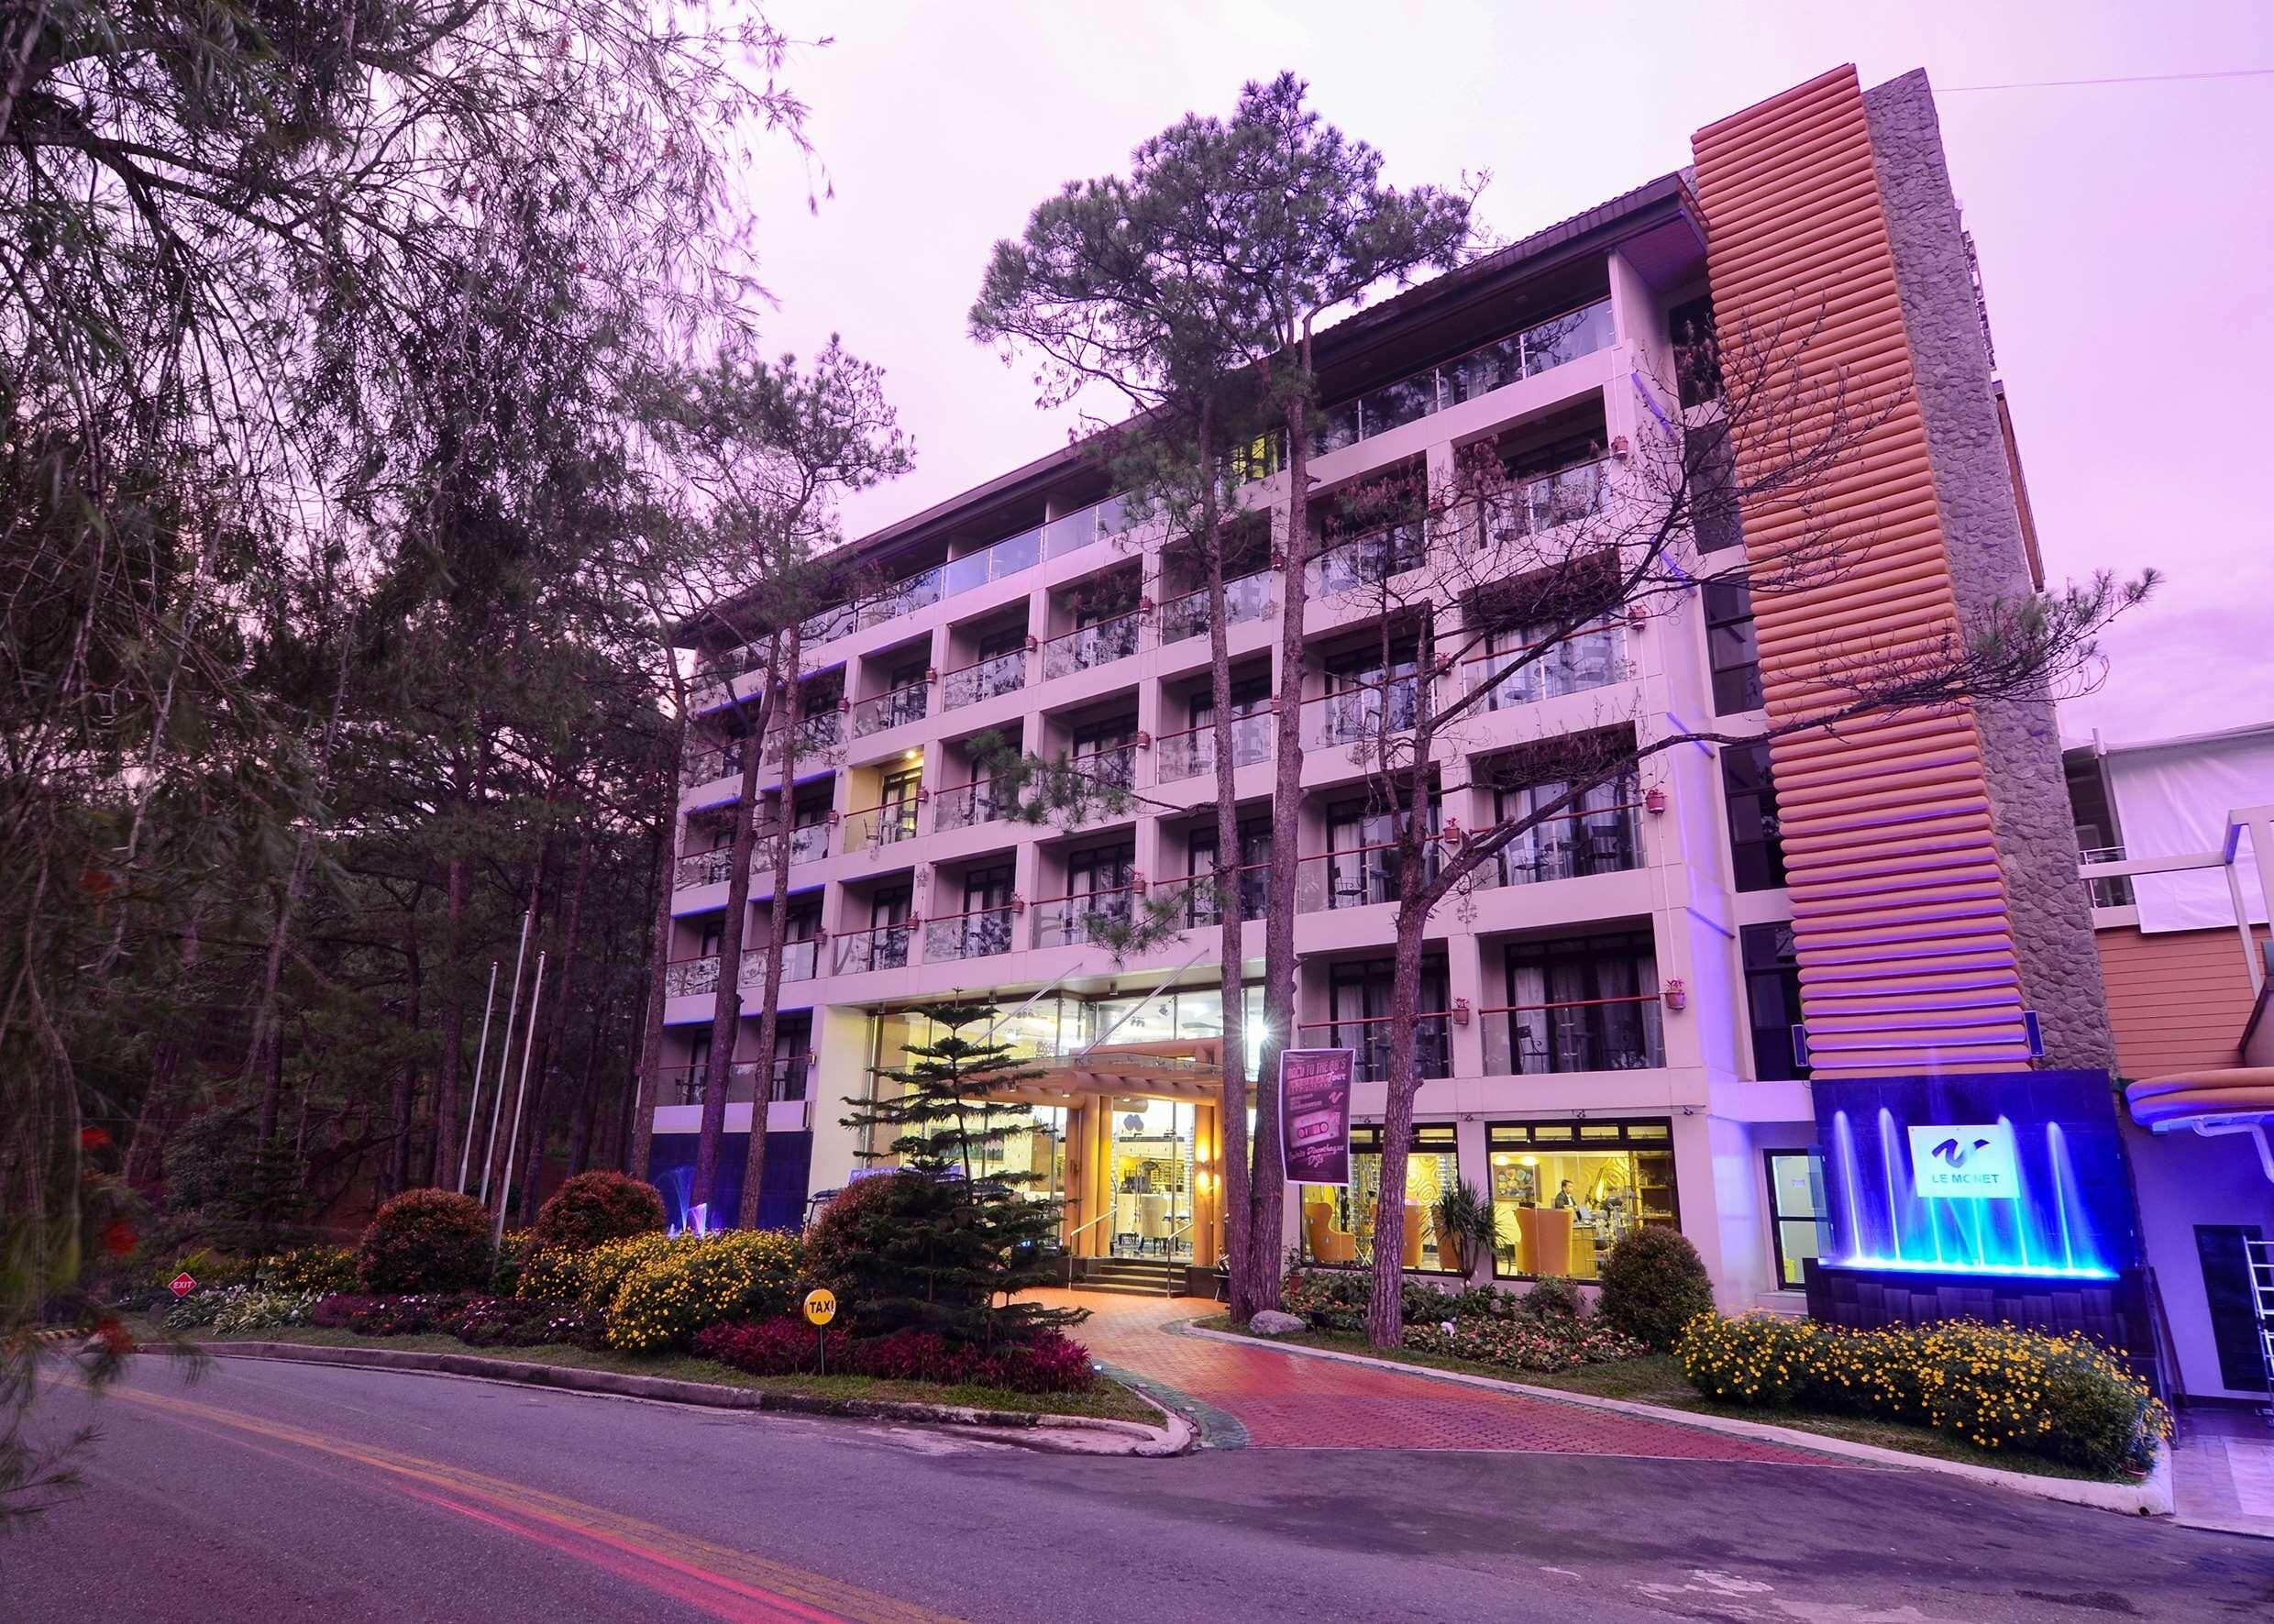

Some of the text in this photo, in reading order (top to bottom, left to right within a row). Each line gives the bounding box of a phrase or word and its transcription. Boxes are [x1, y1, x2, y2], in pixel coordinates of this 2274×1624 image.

[1932, 1174, 1948, 1184] LE
[173, 1281, 193, 1289] EXIT
[810, 1300, 833, 1314] TAXI
